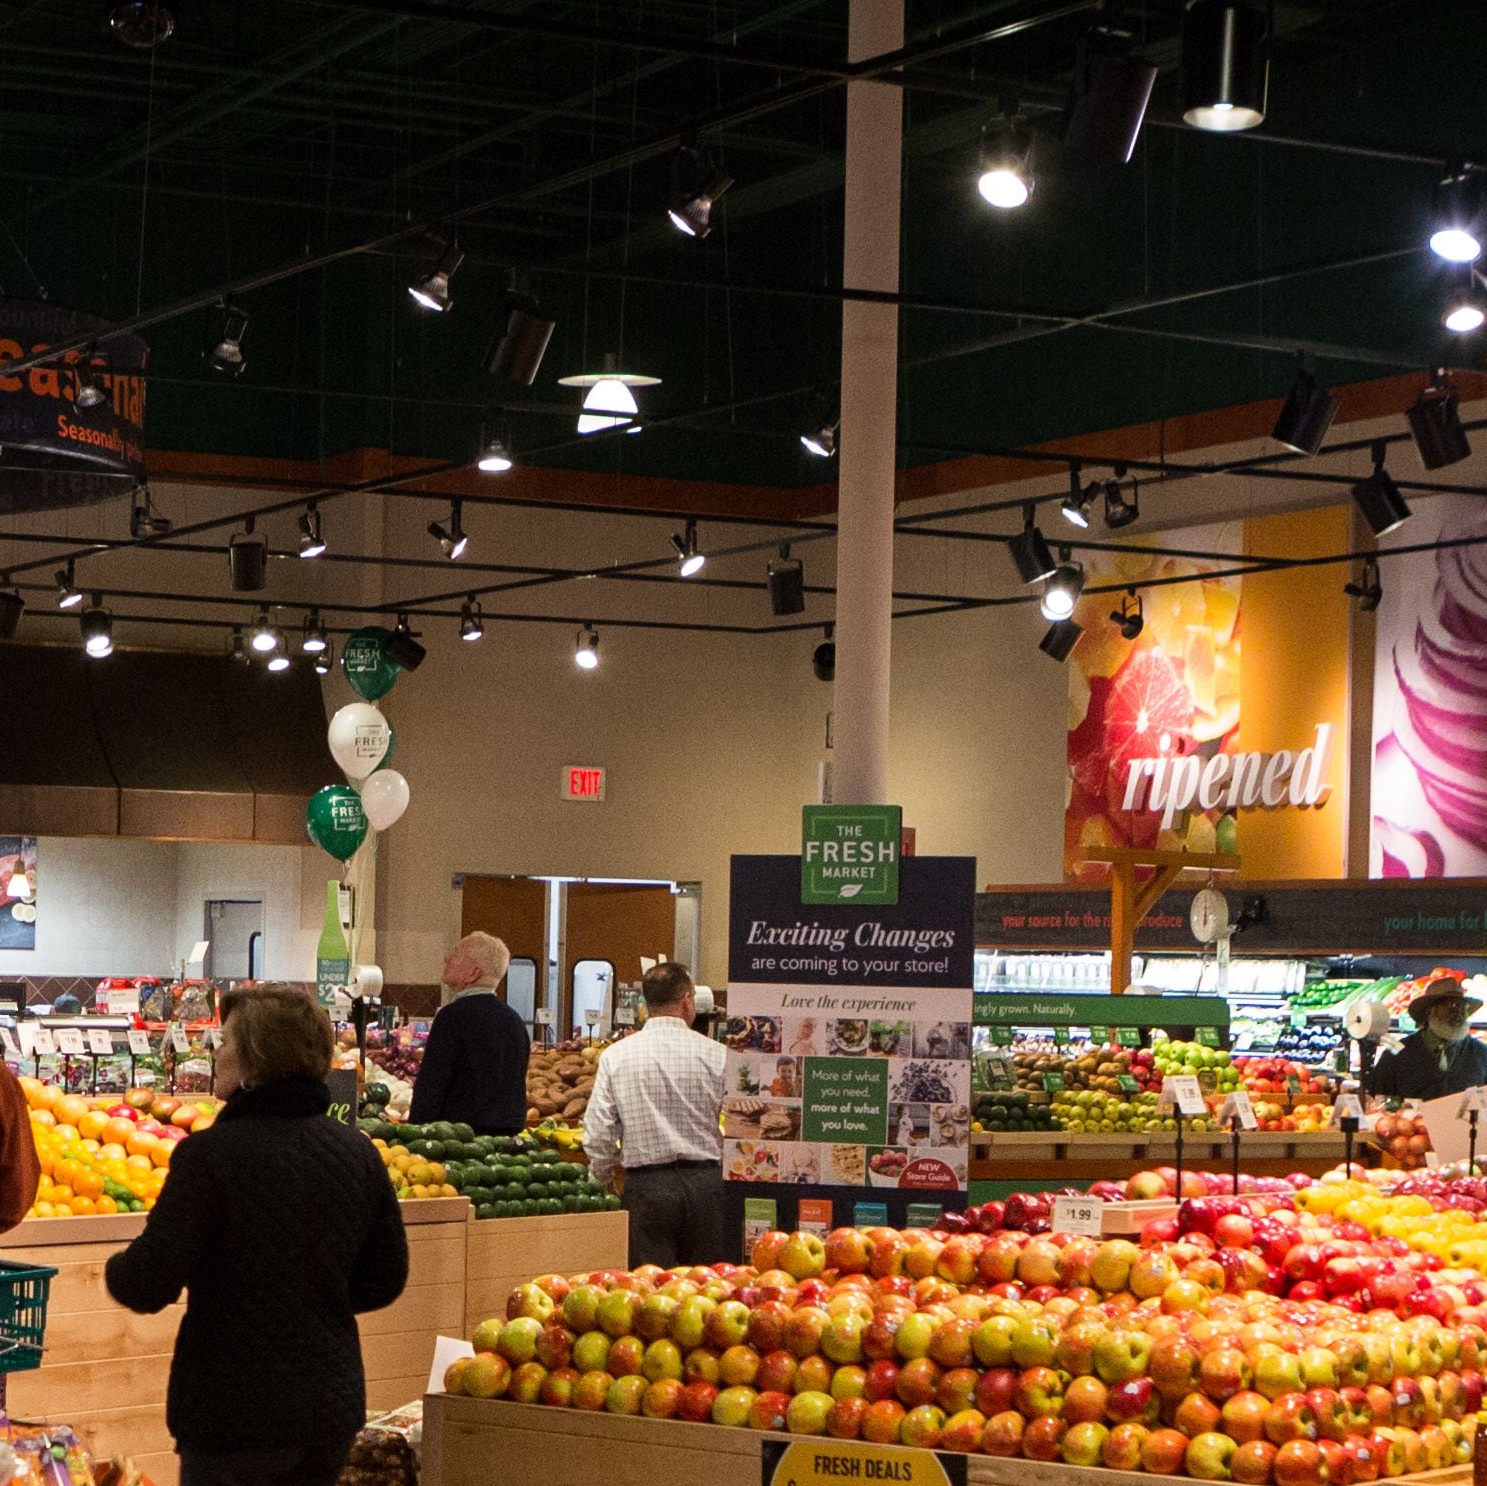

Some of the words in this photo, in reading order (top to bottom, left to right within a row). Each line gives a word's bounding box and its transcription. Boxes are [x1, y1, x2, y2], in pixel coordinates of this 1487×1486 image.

[346, 649, 380, 659] FRESH
[571, 769, 601, 795] EXIT
[1122, 723, 1334, 830] ripened
[332, 807, 362, 818] FRES
[837, 826, 863, 837] THE
[806, 841, 895, 863] FRESH
[822, 867, 876, 879] MARKET
[1002, 915, 1026, 931] your
[1028, 915, 1061, 927] source
[1065, 912, 1079, 927] for
[1082, 912, 1101, 928] the
[1140, 912, 1183, 928] roduce
[1384, 916, 1414, 937] your
[1418, 912, 1455, 929] home
[746, 920, 849, 951] Exciting
[854, 922, 956, 953] Changes
[751, 957, 776, 969] are
[780, 957, 838, 975] coming
[842, 958, 859, 971] to
[862, 961, 901, 976] your
[905, 957, 949, 973] store!
[781, 994, 813, 1008] Love
[817, 995, 836, 1009] the
[841, 998, 916, 1012] experience
[975, 1004, 997, 1019] ingly
[999, 1005, 1031, 1017] grown.
[1033, 1004, 1075, 1018] Naturally.
[812, 1070, 839, 1082] More
[841, 1070, 853, 1082] of
[856, 1071, 880, 1083] what
[820, 1087, 841, 1098] you
[811, 1103, 838, 1115] more
[840, 1102, 853, 1114] of
[854, 1103, 880, 1115] what
[821, 1120, 842, 1132] you
[843, 1119, 869, 1132] love.
[919, 1162, 941, 1173] NEW
[907, 1172, 926, 1182] Store
[927, 1173, 952, 1183] Guide
[814, 1456, 861, 1478] FRESH
[865, 1459, 912, 1481] DEALS
